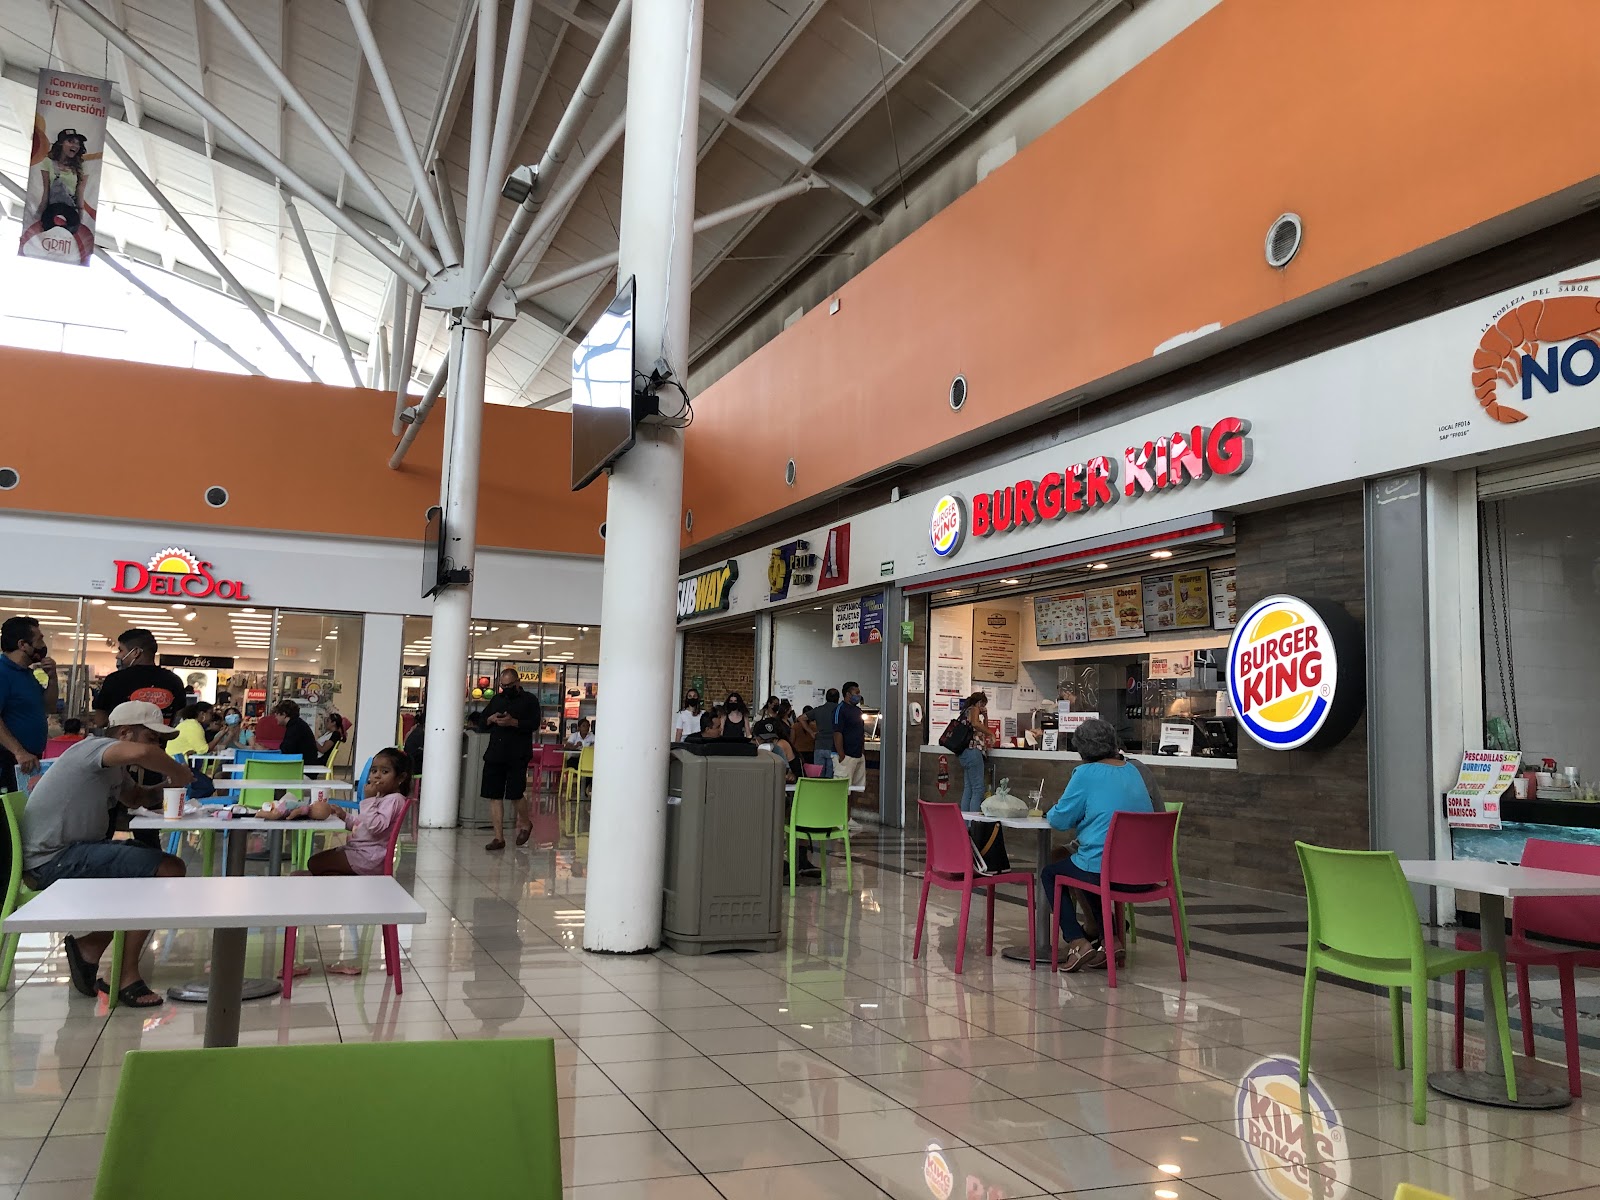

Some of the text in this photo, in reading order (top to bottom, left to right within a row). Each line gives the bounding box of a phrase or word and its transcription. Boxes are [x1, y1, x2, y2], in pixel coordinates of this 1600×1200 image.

[50, 76, 99, 93] ¡Convierte
[45, 87, 102, 104] tus compras
[55, 100, 106, 118] diversión!
[41, 237, 72, 254] GRAN
[1480, 284, 1589, 333] LA NOBLEZA DEL SABOR
[1521, 338, 1600, 401] NO
[1438, 424, 1454, 432] LOCAL
[972, 417, 1247, 537] BURGER KING
[932, 502, 956, 531] BURGER
[934, 512, 957, 546] KING
[790, 553, 815, 570] PETIT
[1116, 588, 1137, 597] Cheese
[837, 611, 860, 622] TARJETAS
[1240, 625, 1319, 679] BURGER
[183, 656, 211, 668] bebés
[1136, 680, 1160, 691] pepsi
[1243, 650, 1322, 714] KING
[1464, 752, 1504, 763] PESCADILLAS
[1462, 763, 1491, 772] BURRITOS
[1448, 797, 1471, 808] SOPA DE
[1448, 808, 1477, 817] MARISCOS
